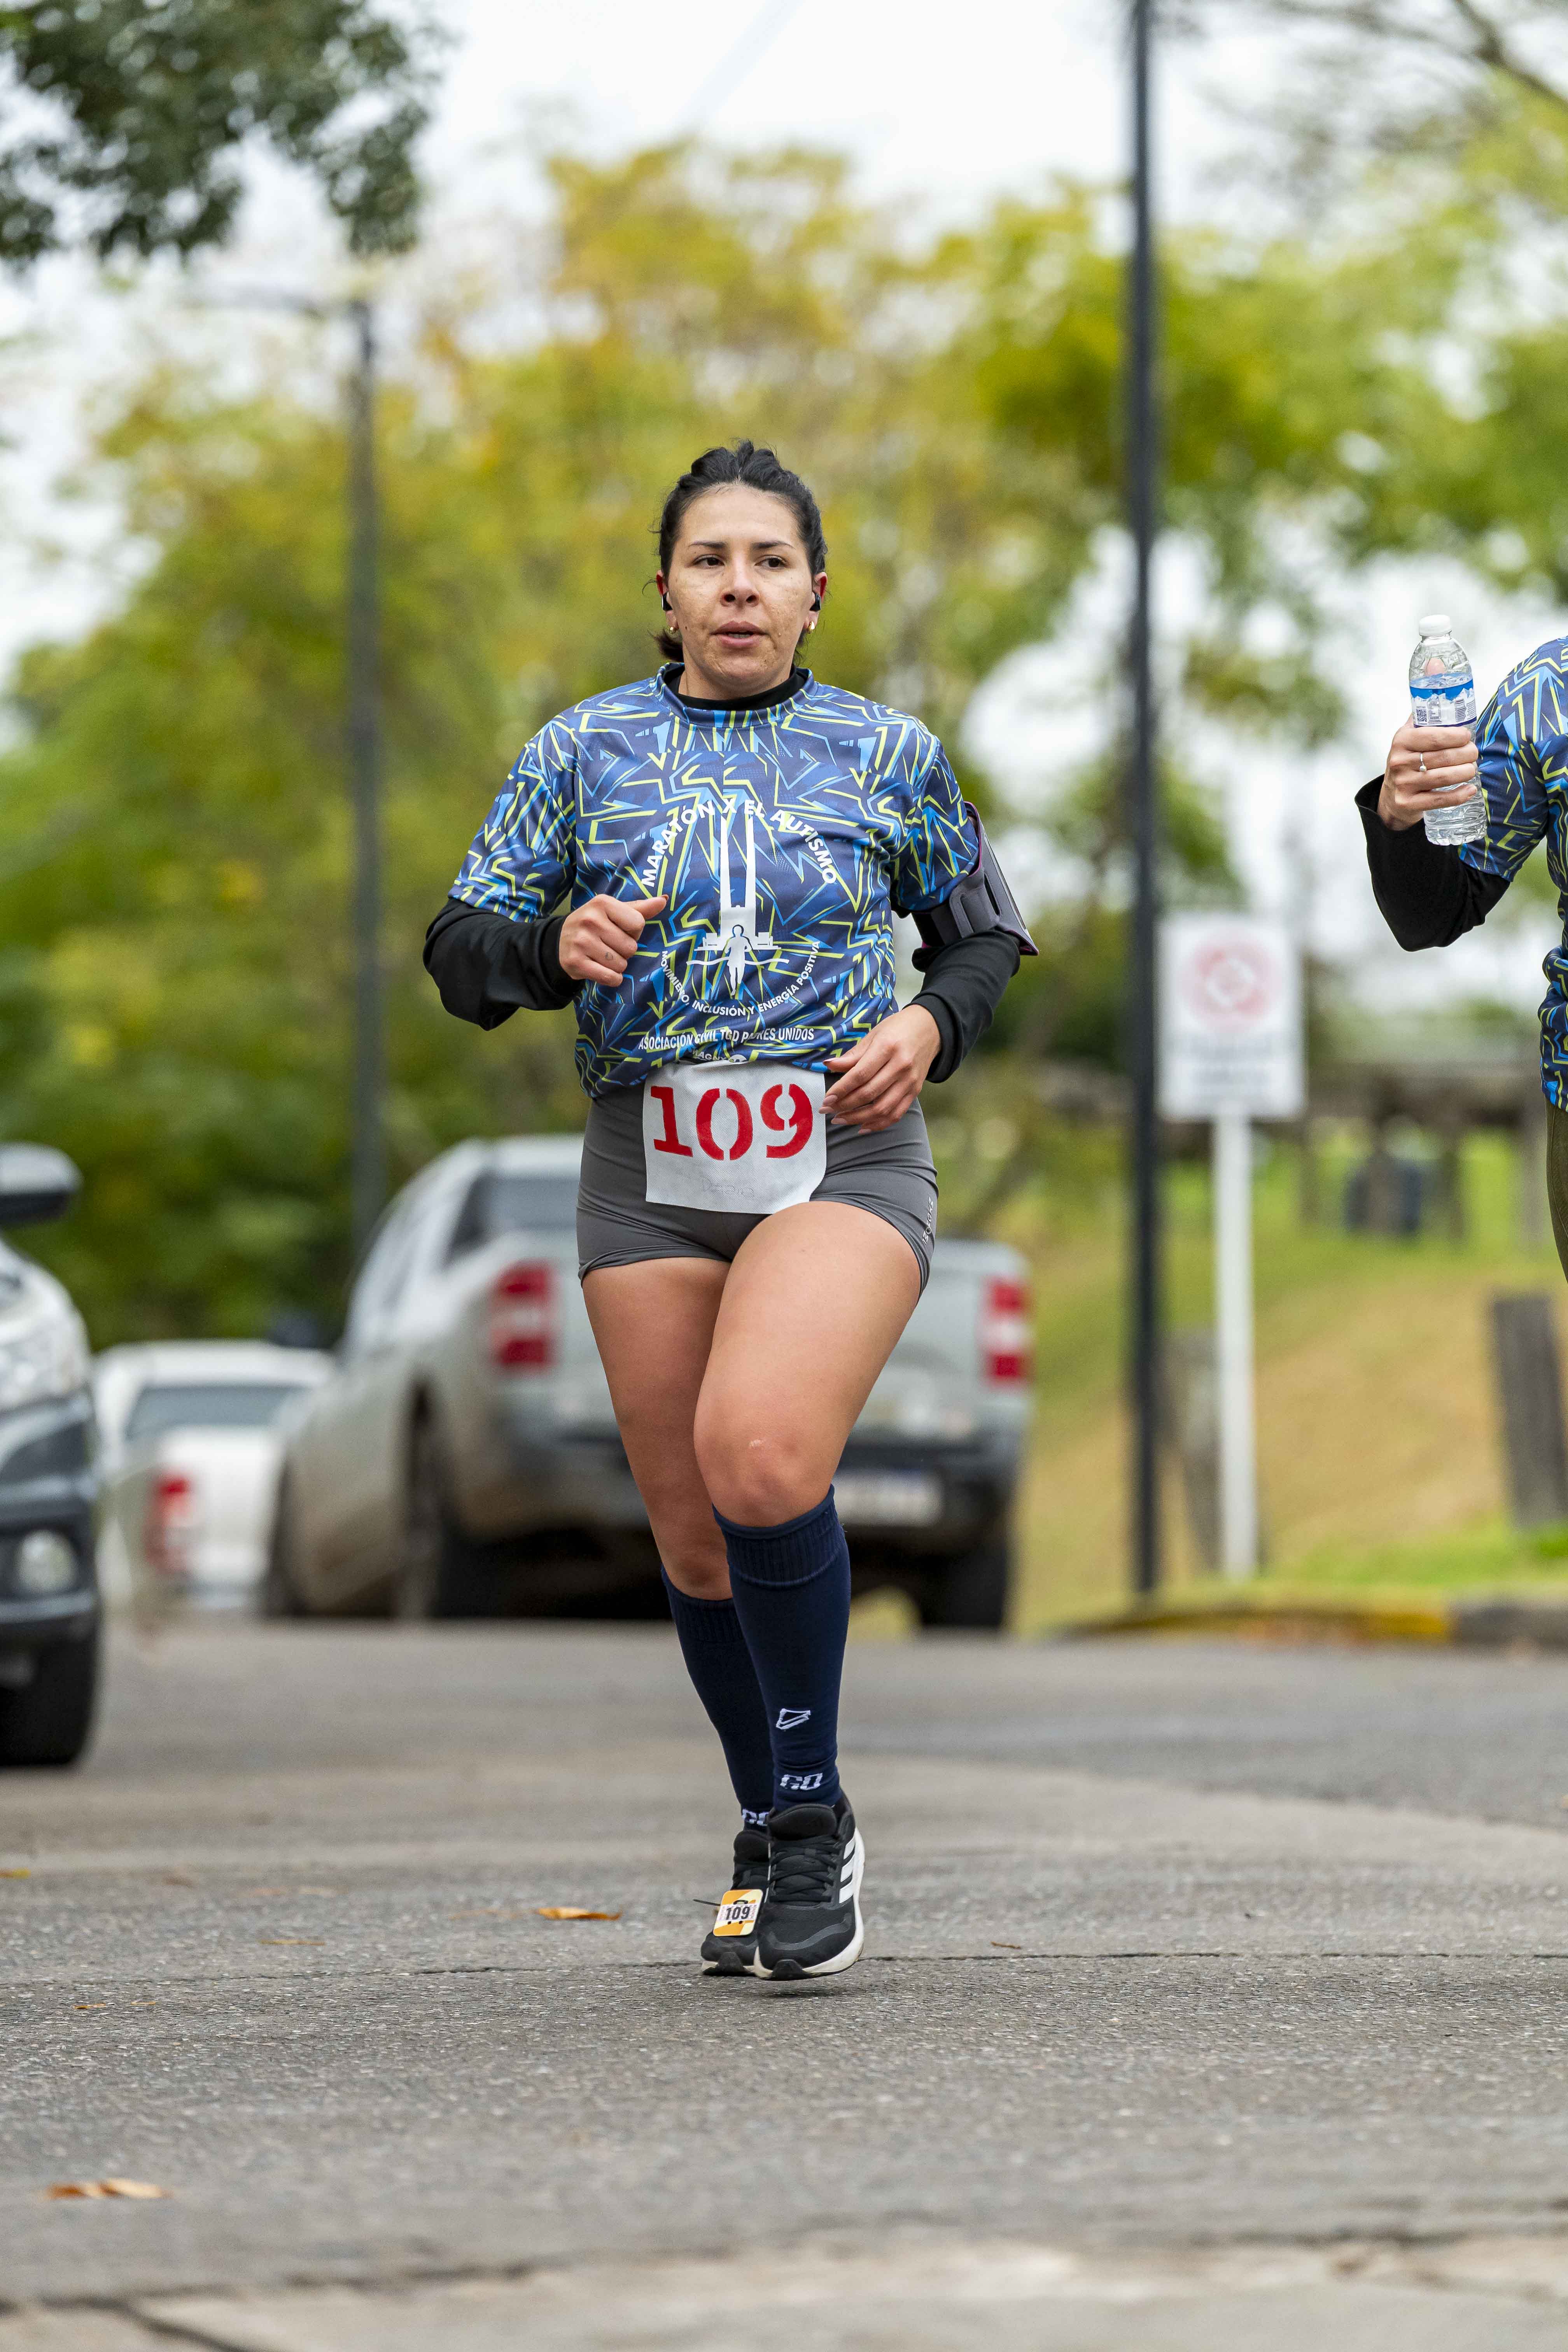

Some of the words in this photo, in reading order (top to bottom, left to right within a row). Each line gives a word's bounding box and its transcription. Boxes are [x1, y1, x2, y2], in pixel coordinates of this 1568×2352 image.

[641, 800, 715, 887] MARATÓN
[722, 797, 737, 814] X
[744, 799, 765, 818] EL
[770, 809, 836, 884] AUTISMO
[692, 1000, 746, 1016] INCLUSIÓN
[747, 1006, 755, 1014] Y
[757, 984, 799, 1012] ENERGÍA
[796, 941, 820, 985] POSITIVA
[638, 1032, 693, 1050] ASOCIACIÓN
[695, 1030, 718, 1044] CIVIL
[720, 1029, 739, 1042] TGD
[778, 1028, 814, 1041] UNIDOS
[651, 1084, 813, 1160] 109
[726, 1906, 750, 1920] 109
